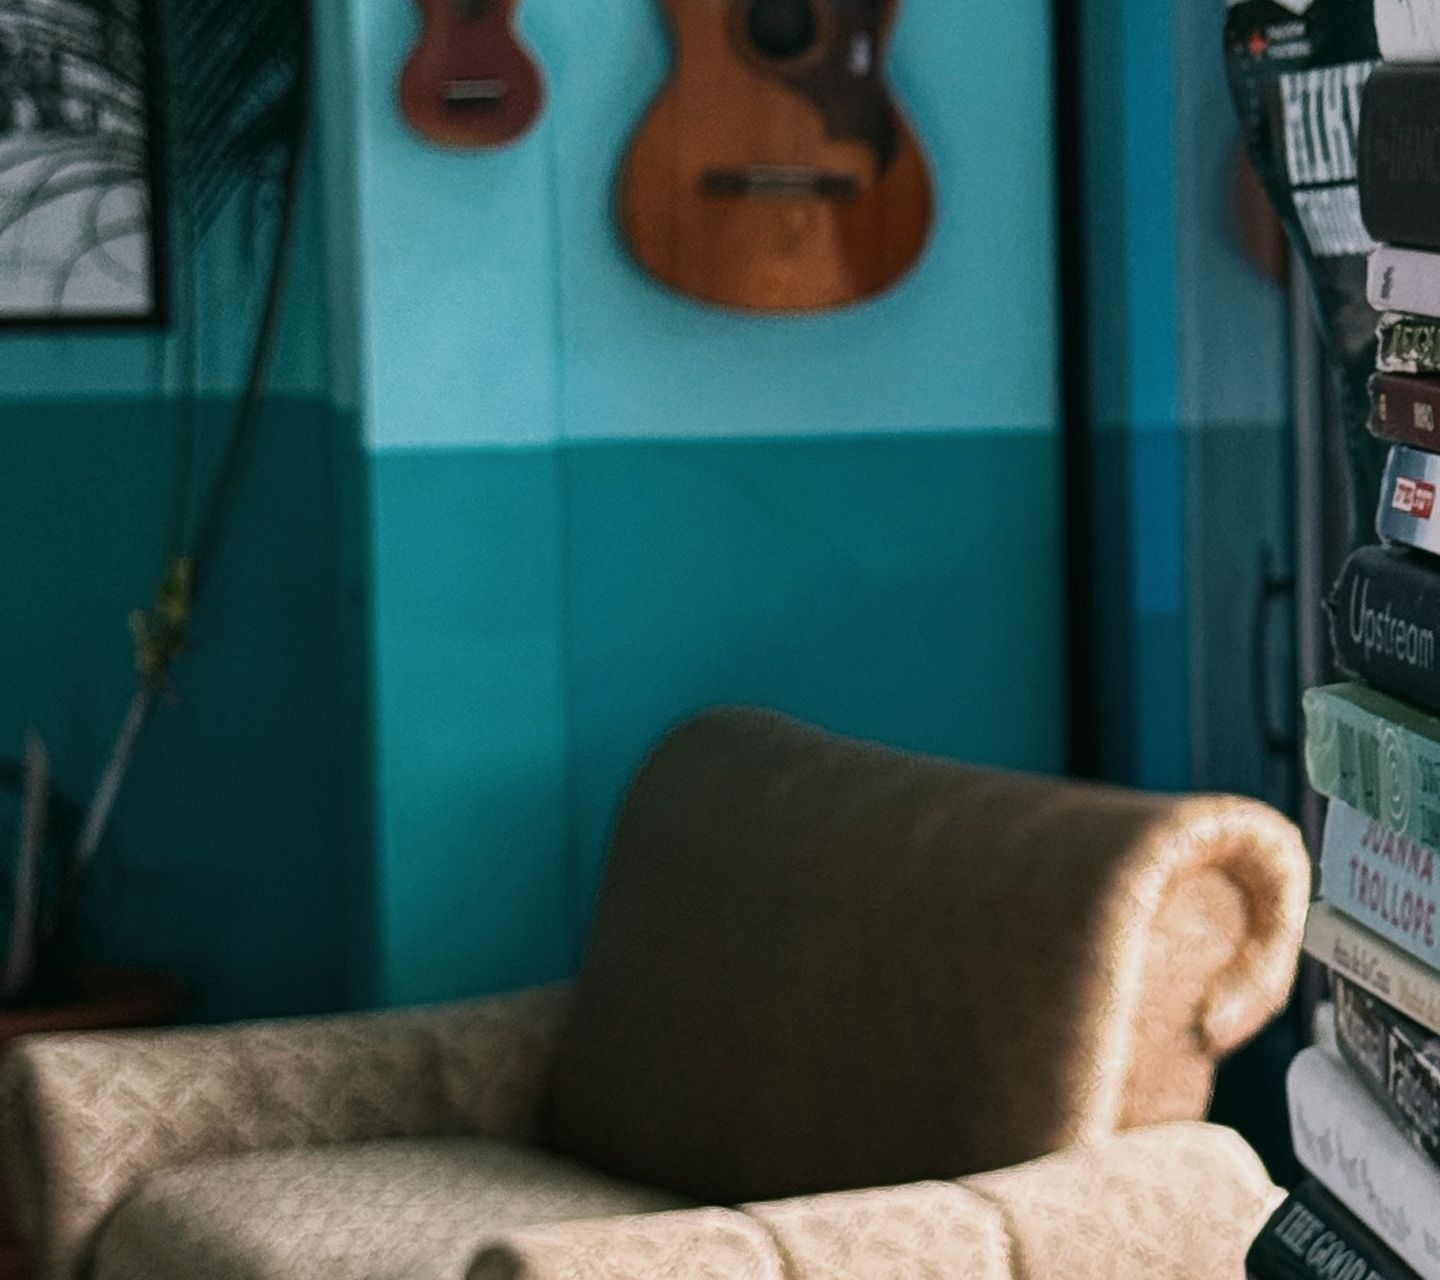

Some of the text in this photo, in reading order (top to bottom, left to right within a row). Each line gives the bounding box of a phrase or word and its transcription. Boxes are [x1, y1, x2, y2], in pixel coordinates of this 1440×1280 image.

[1351, 574, 1434, 669] Upstream
[1361, 818, 1434, 886] JOANNA
[1349, 855, 1436, 947] TROLLOPE
[1275, 1202, 1319, 1259] THE
